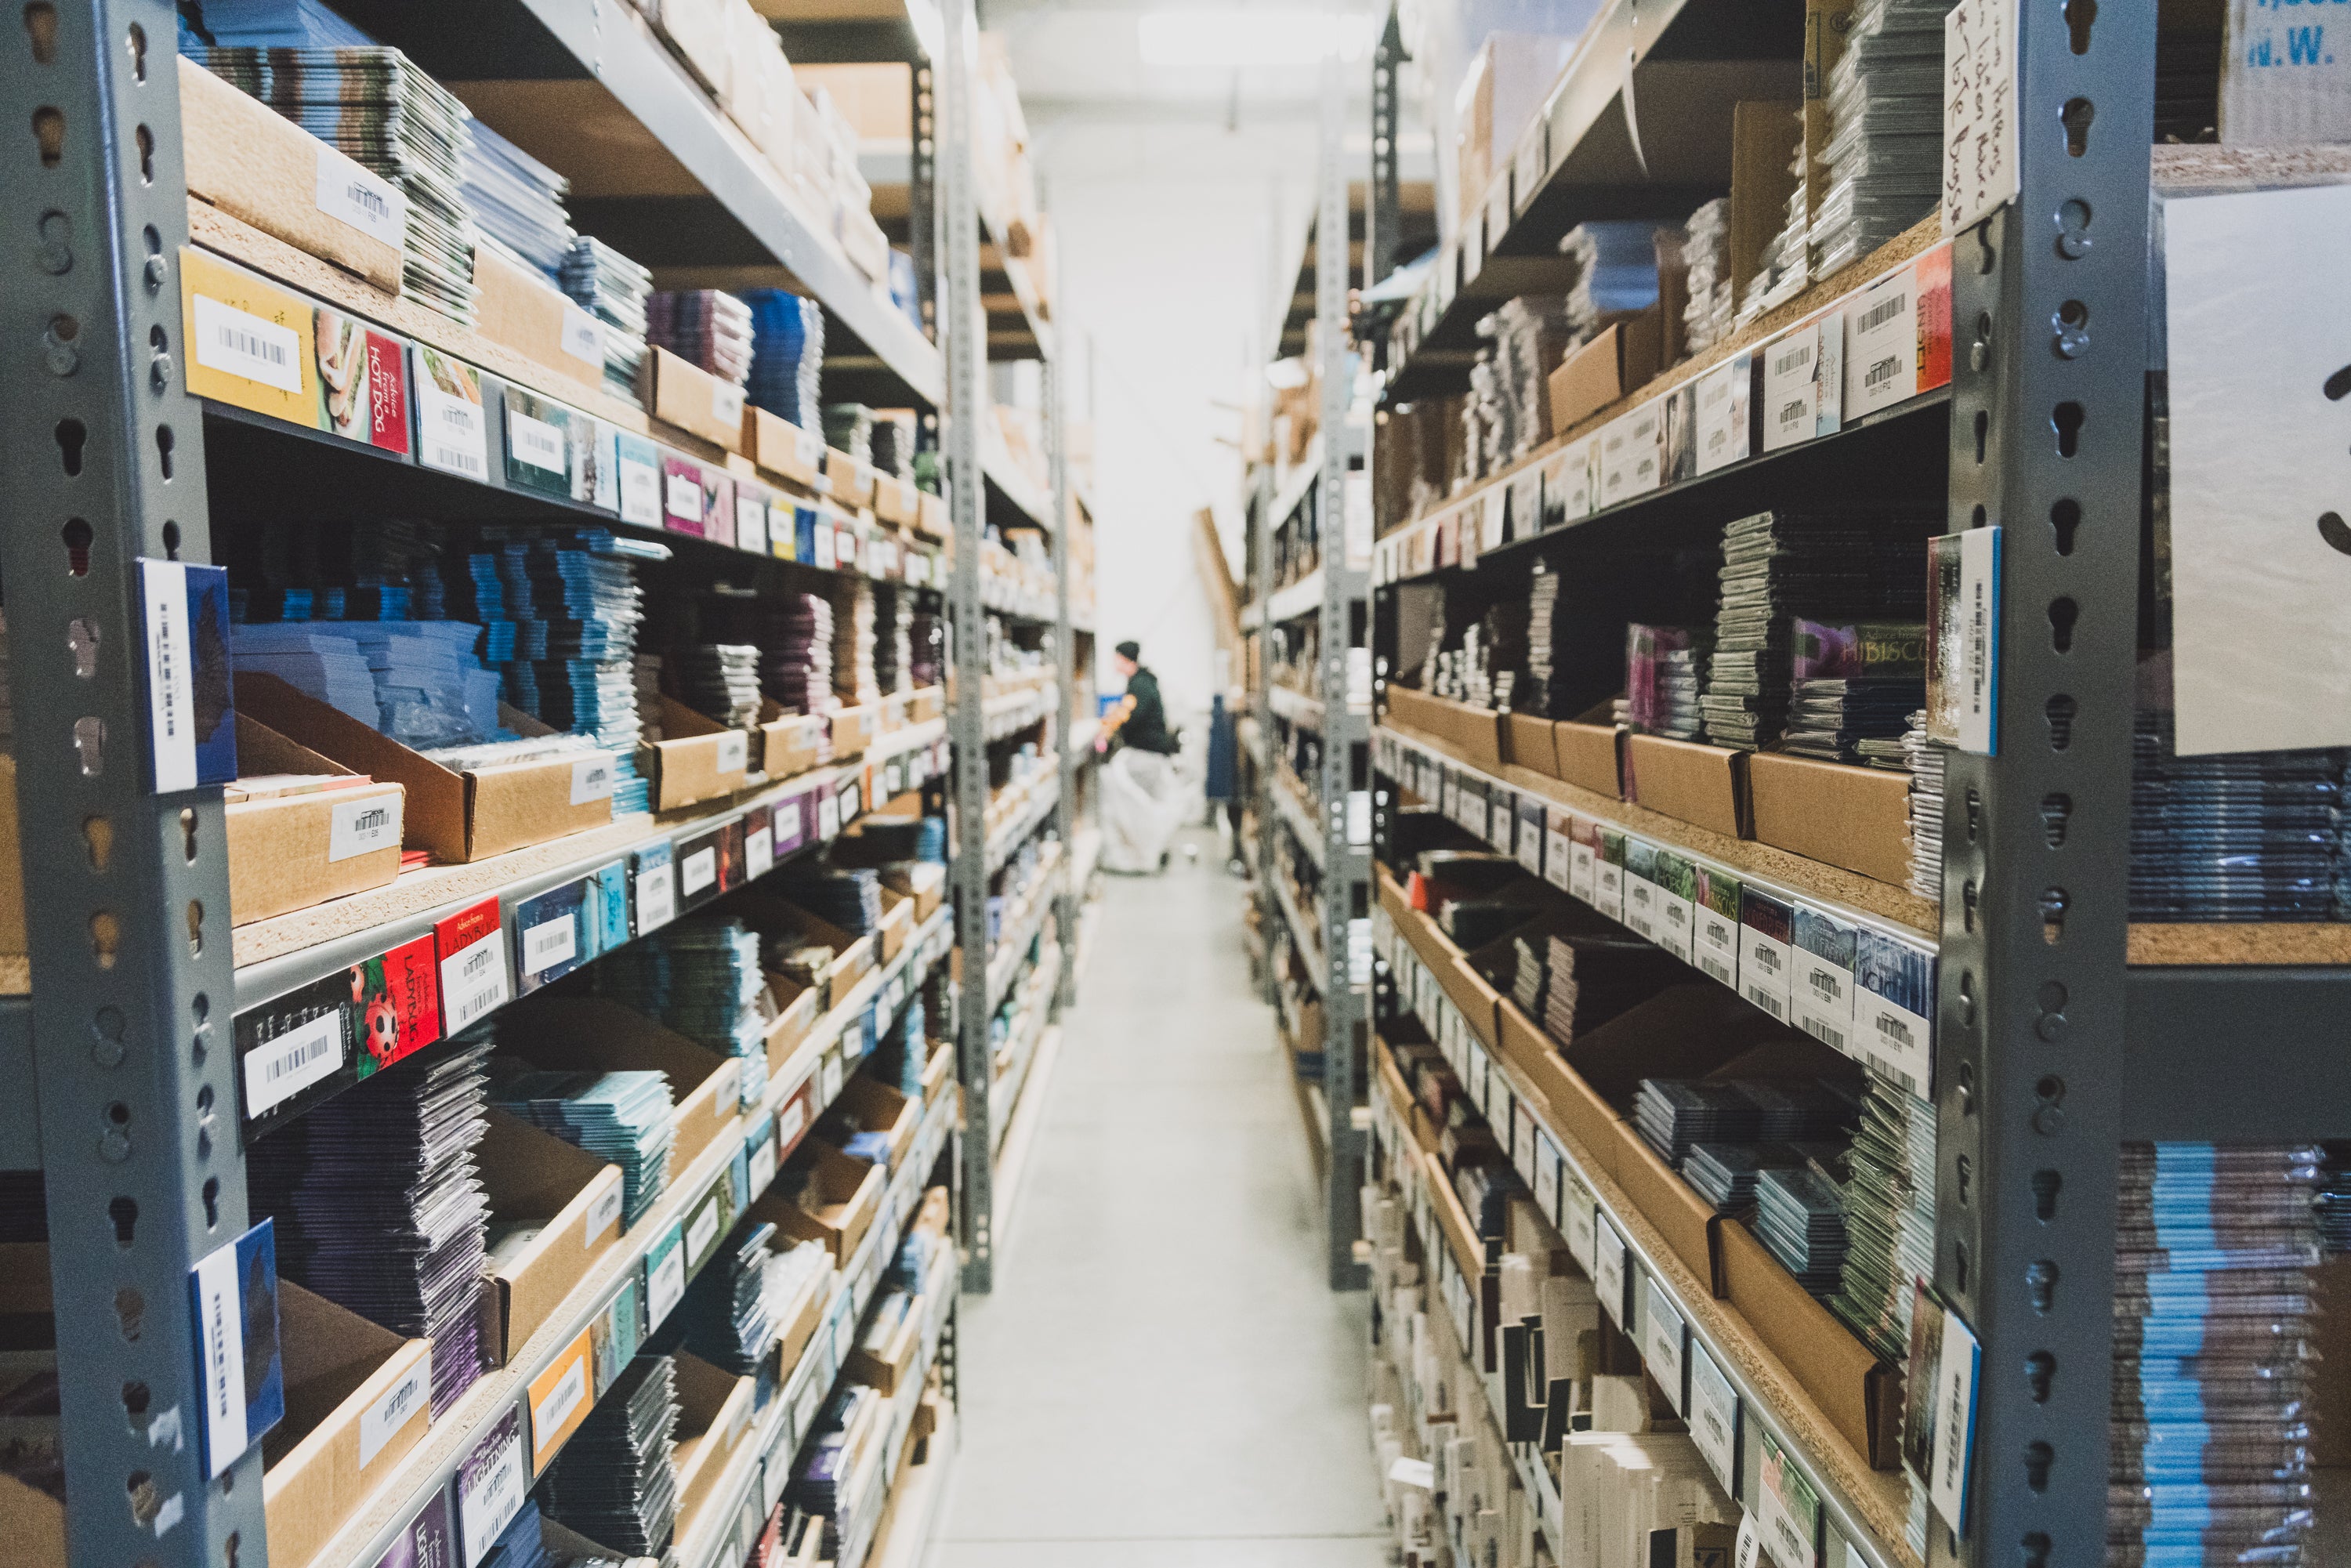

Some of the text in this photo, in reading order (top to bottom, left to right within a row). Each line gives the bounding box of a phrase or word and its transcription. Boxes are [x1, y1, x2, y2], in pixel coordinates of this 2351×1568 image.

[370, 346, 386, 433] HOT DOG
[382, 371, 390, 415] from a
[389, 371, 398, 418] Advice
[1864, 628, 1896, 641] Advice
[1897, 629, 1919, 640] from
[404, 954, 418, 1042] LADYBUG
